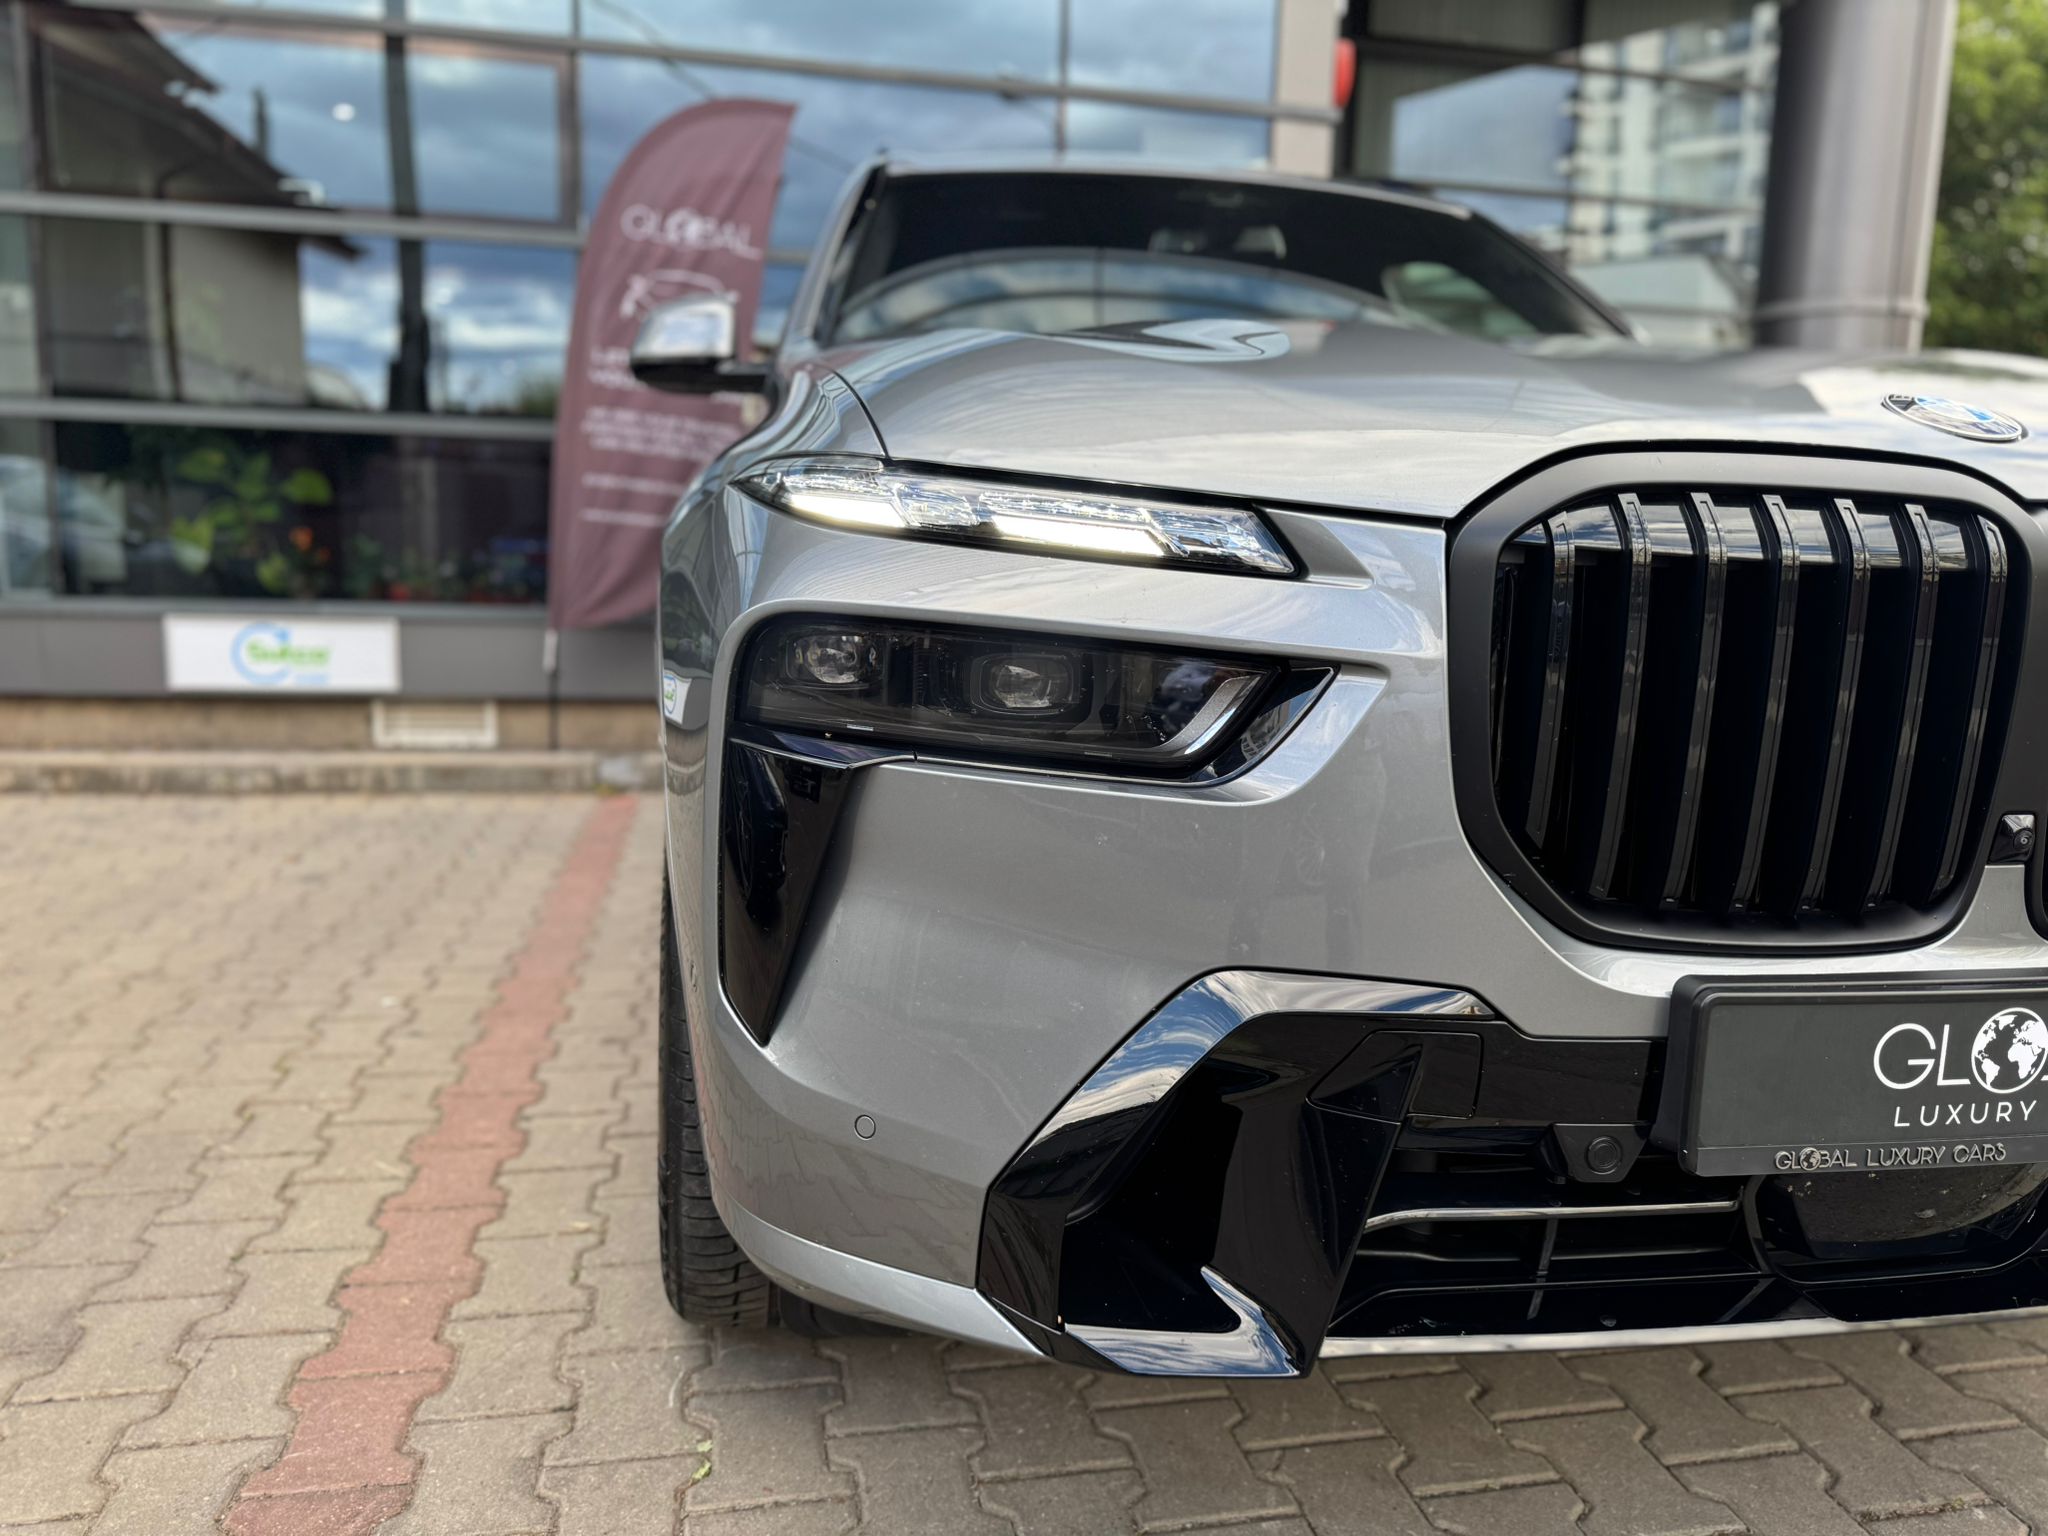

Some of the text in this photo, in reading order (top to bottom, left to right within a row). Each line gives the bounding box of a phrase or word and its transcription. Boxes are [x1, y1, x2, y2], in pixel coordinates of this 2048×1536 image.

[1873, 1007, 2048, 1093] GLO
[1894, 1100, 2037, 1127] LUXURY
[1775, 1142, 2006, 1171] GLOBAL LUXURY CARS
